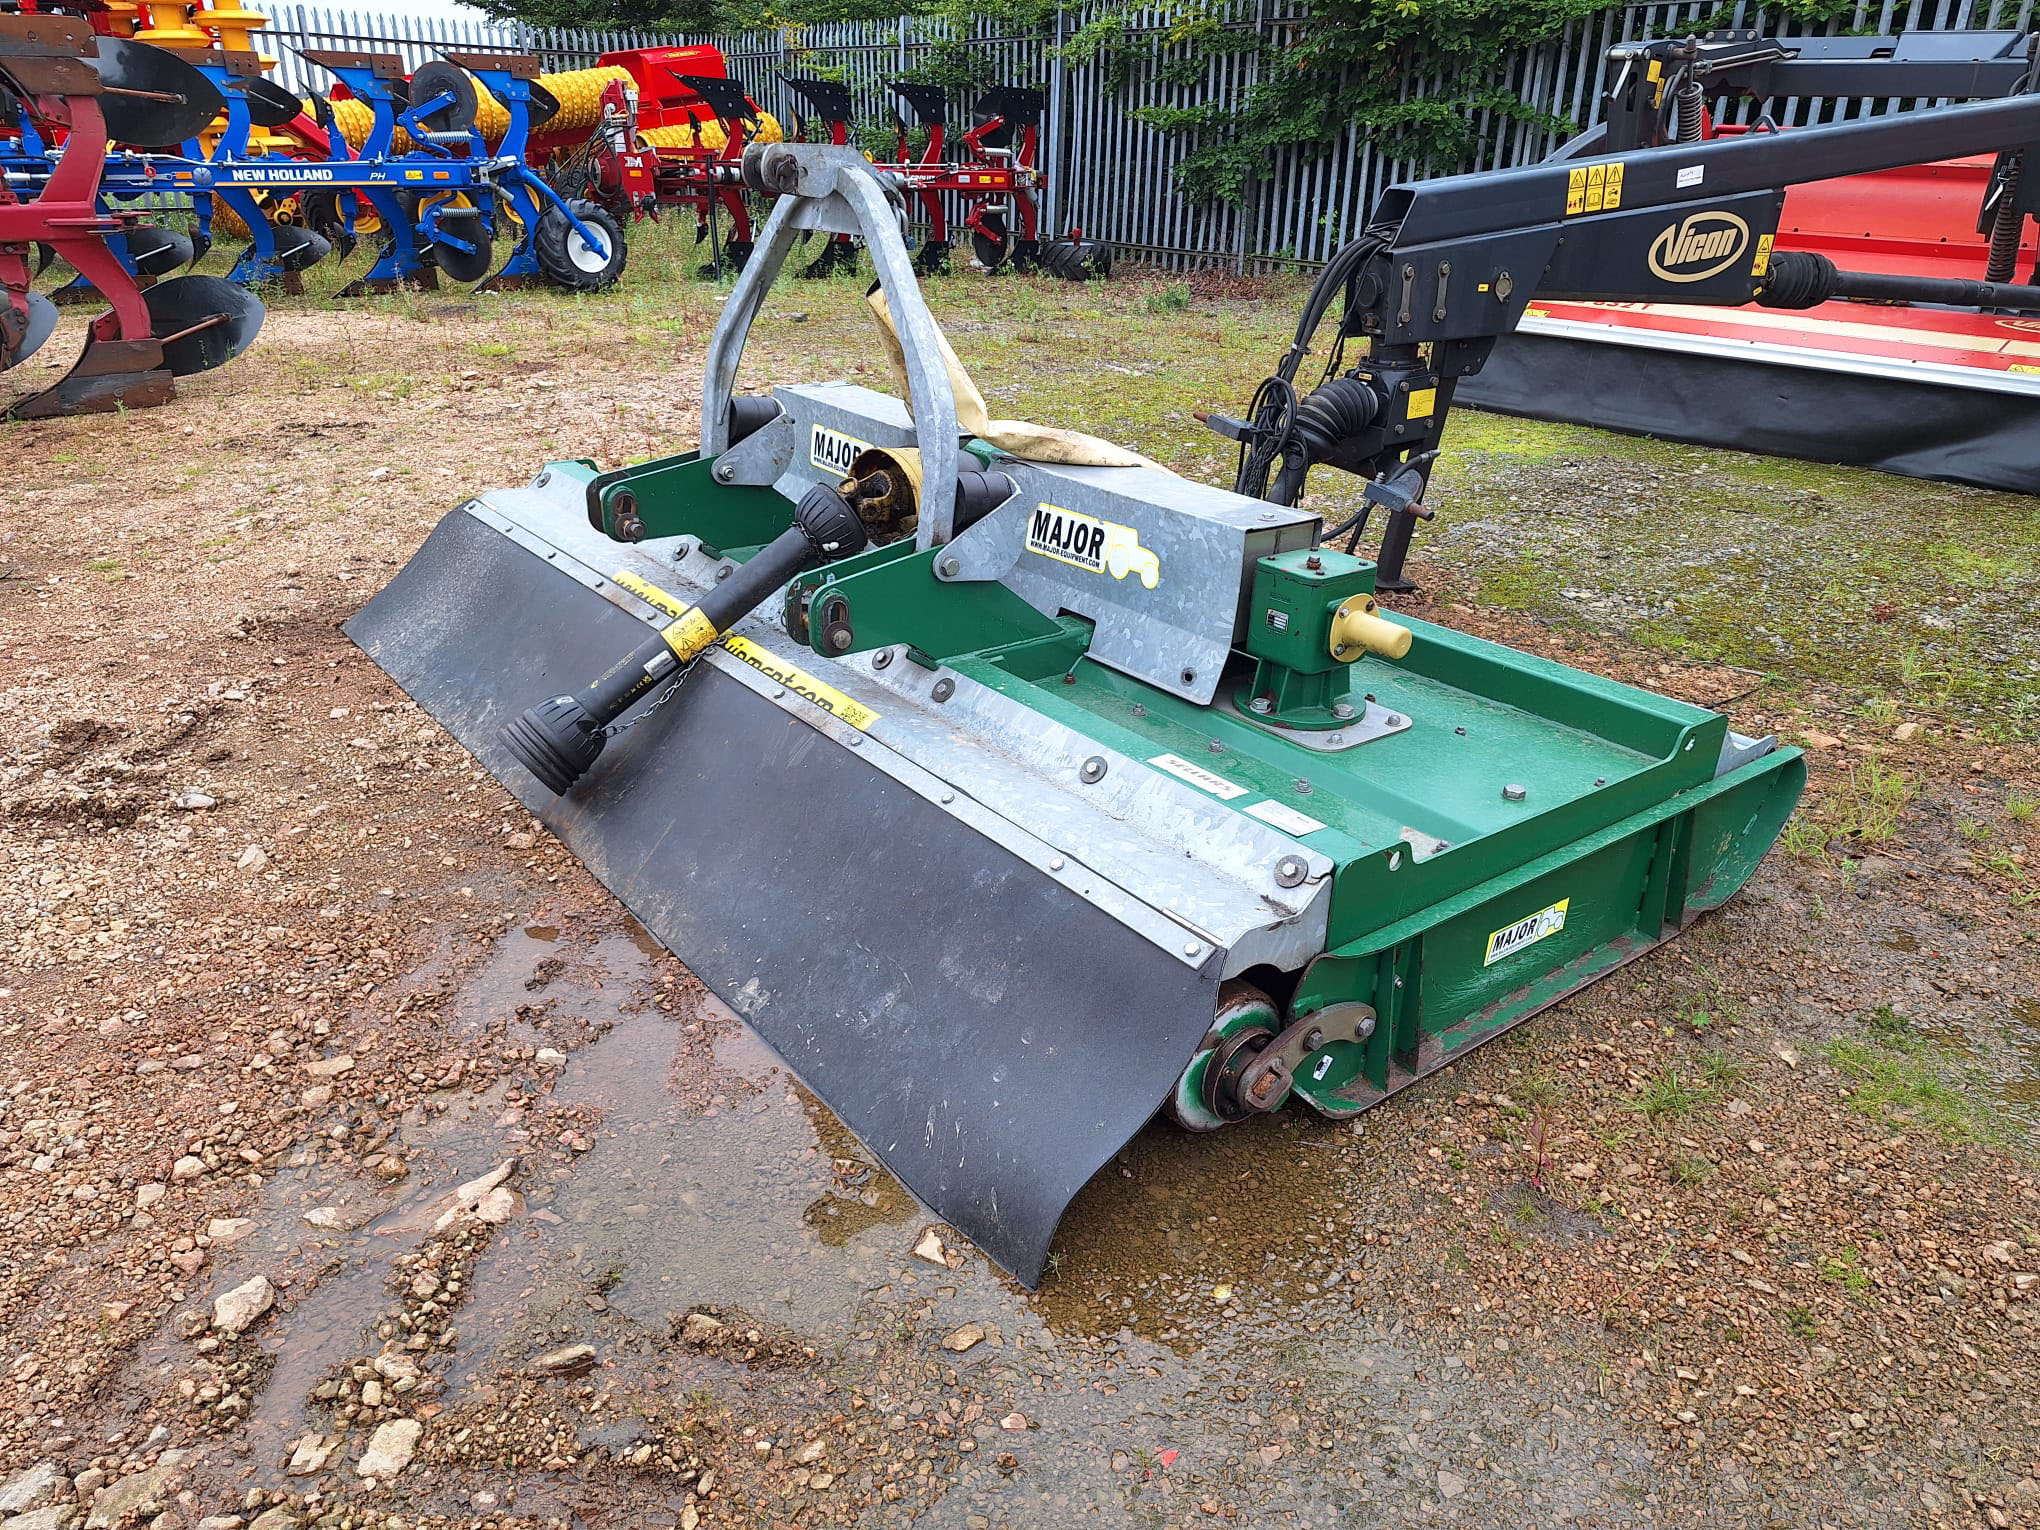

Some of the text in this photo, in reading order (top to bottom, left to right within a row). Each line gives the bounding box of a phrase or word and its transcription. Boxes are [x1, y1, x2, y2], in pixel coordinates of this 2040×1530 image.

[232, 169, 333, 181] NEW HOLLAND
[369, 172, 386, 181] PH
[1662, 220, 1740, 268] Vicon
[1031, 509, 1105, 560] MAJOR
[1030, 540, 1100, 568] WWW.MAJOR-EQUIPMENT.COM
[1492, 918, 1538, 953] MAJOR
